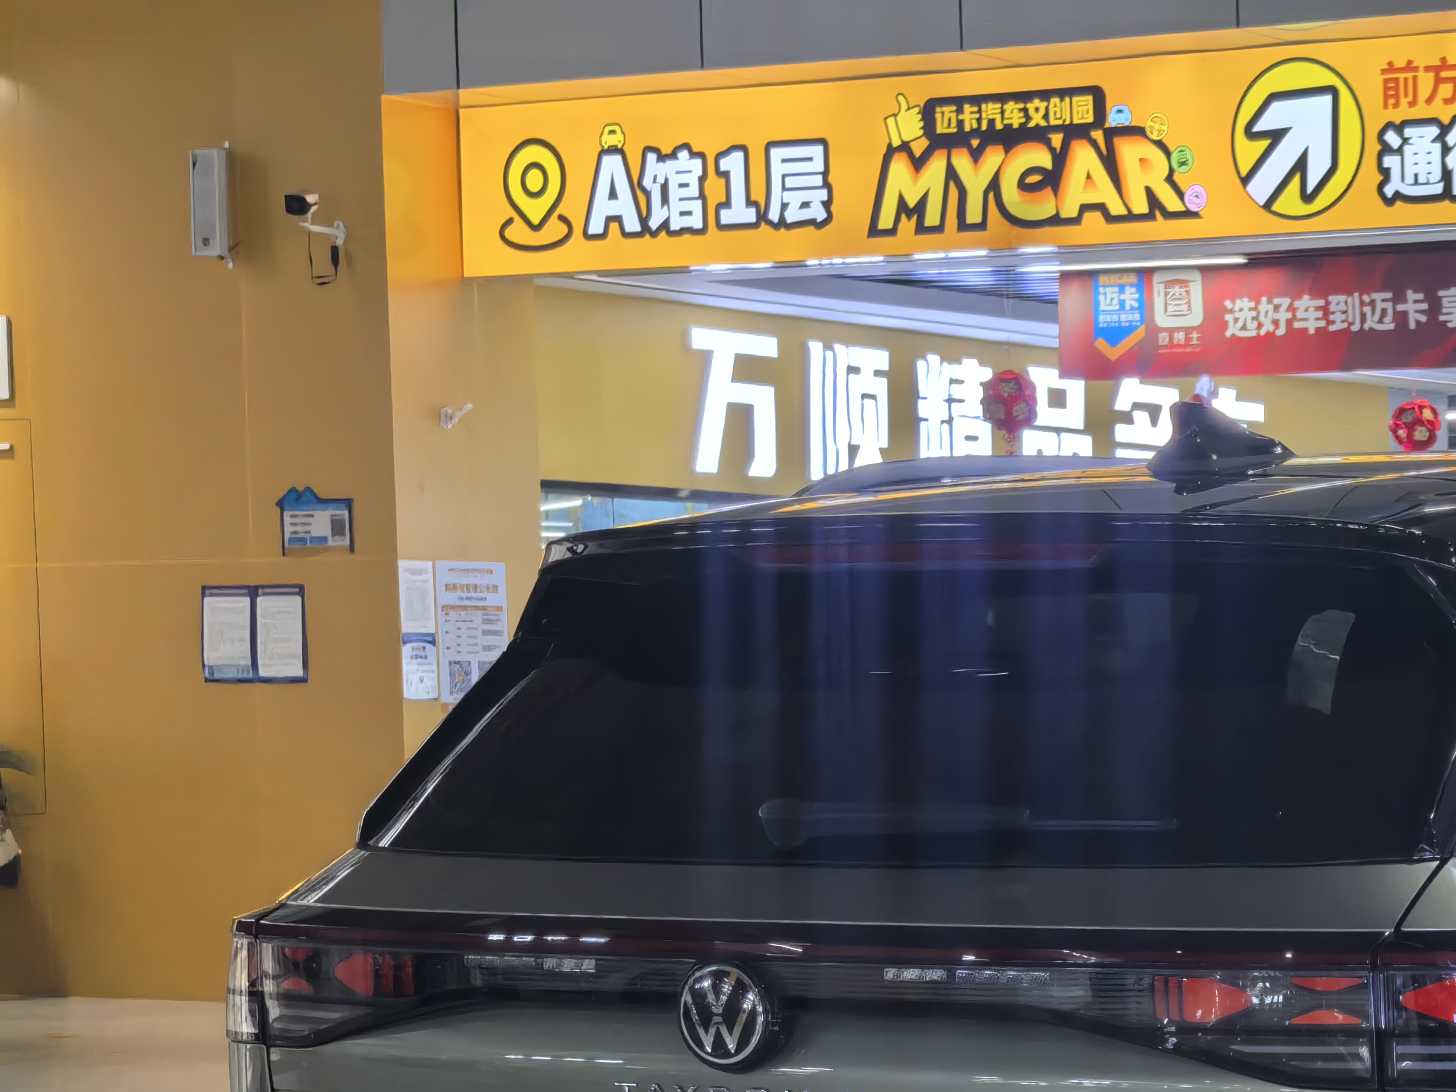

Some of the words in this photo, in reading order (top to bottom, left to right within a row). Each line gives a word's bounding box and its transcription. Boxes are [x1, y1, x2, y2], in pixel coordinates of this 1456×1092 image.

[934, 94, 1096, 135] 迈卡汽车文创园
[585, 142, 830, 237] A馆1层
[874, 132, 1188, 231] MYCAR
[1098, 286, 1140, 311] 迈卡
[1223, 289, 1429, 338] 选好车到迈卡
